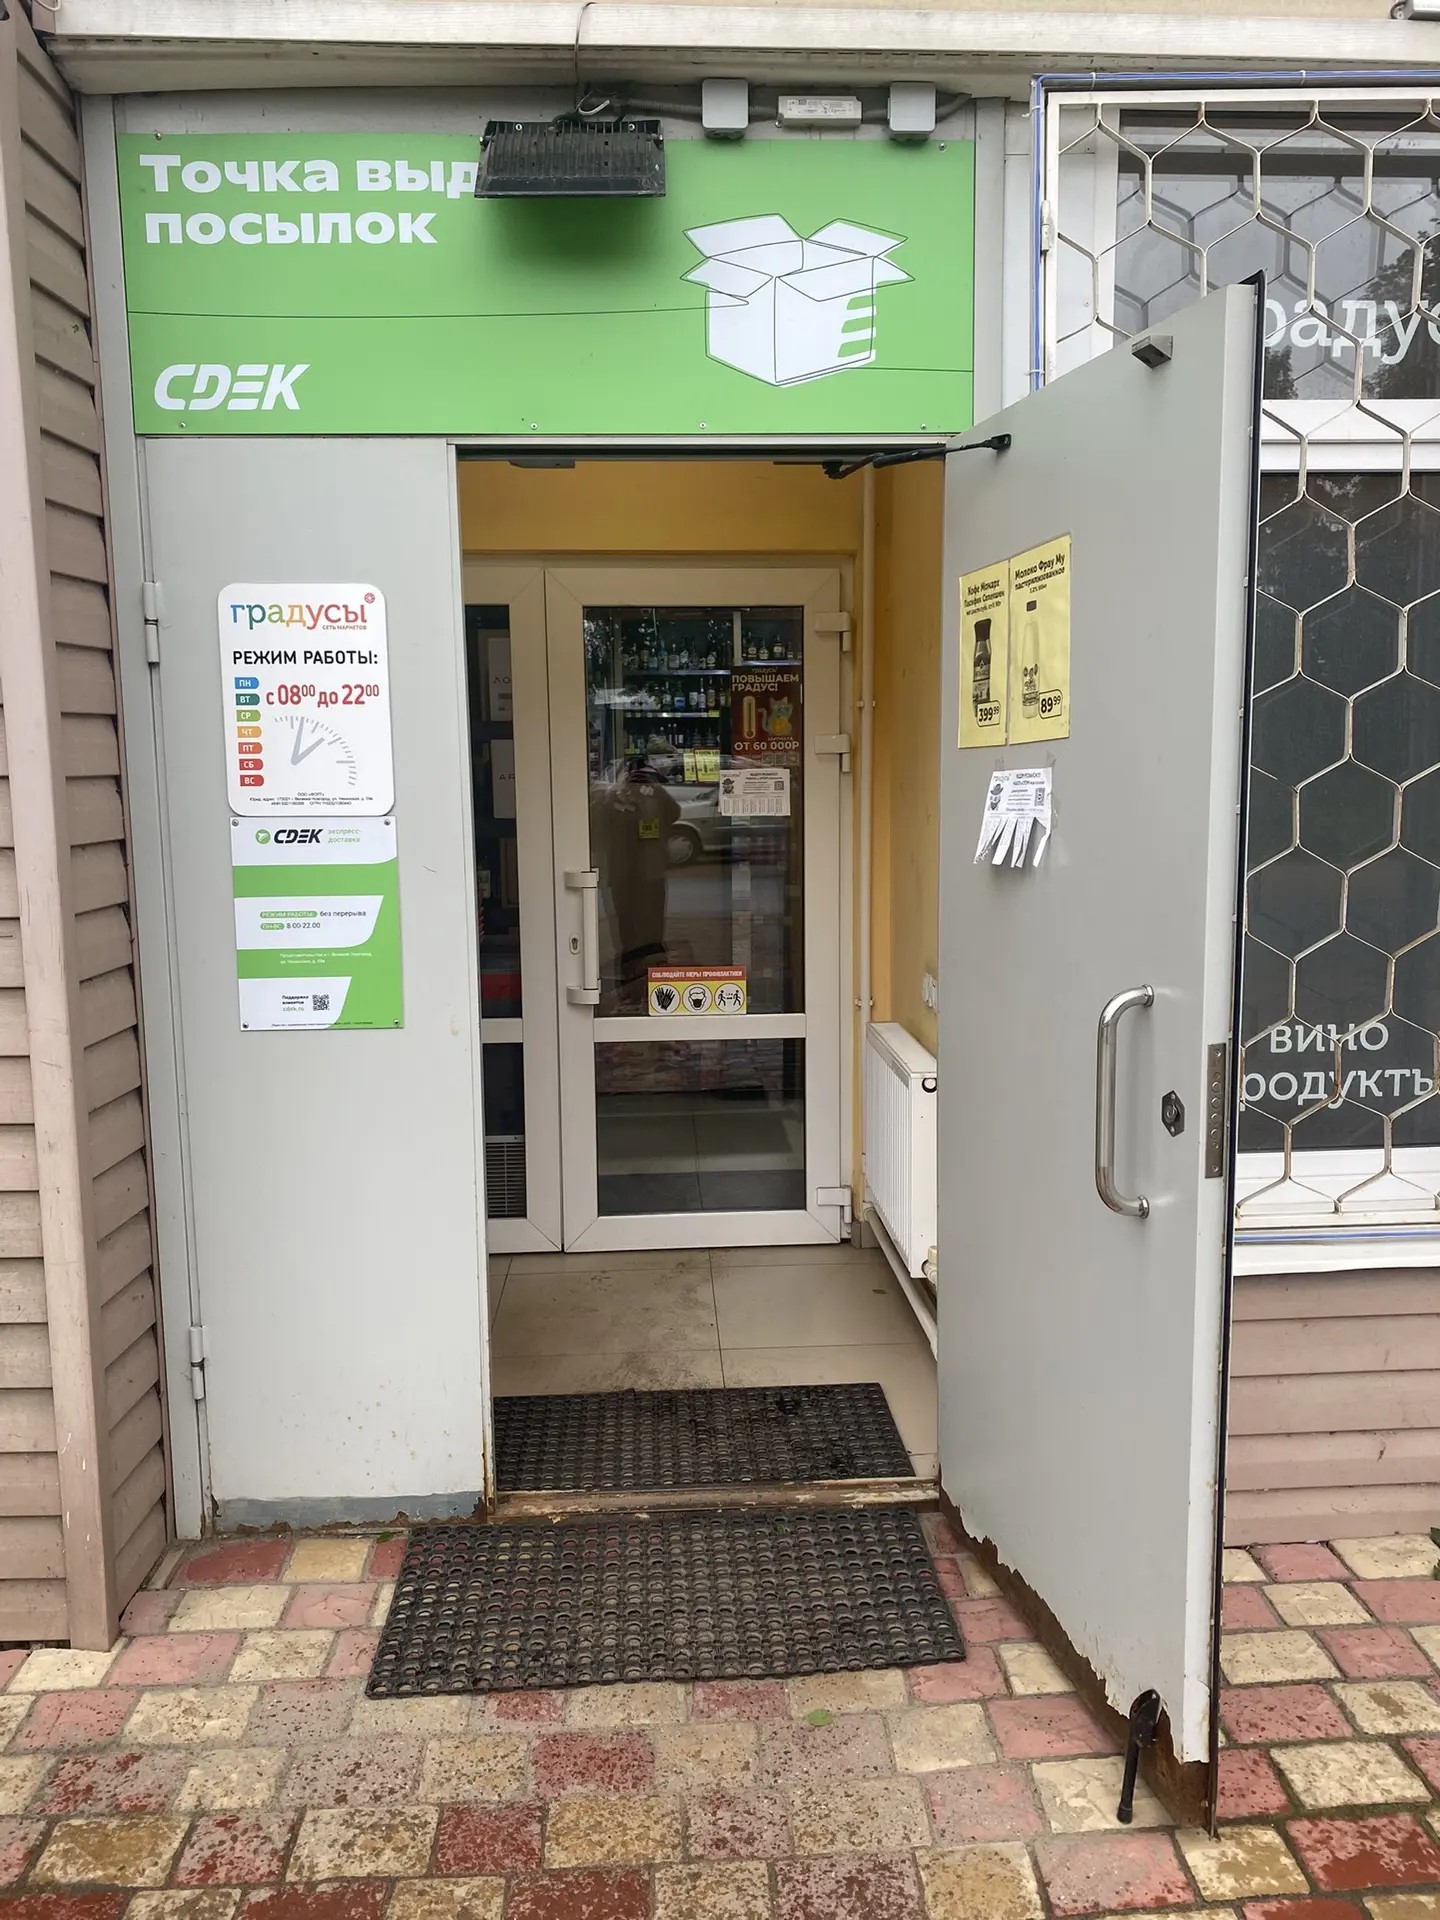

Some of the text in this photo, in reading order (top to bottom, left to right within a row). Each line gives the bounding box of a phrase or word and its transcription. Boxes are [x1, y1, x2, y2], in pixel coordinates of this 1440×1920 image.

[139, 154, 339, 193] Точка
[145, 212, 438, 244] посылок
[154, 363, 310, 410] CDEK
[1014, 565, 1038, 581] Молоко
[1055, 553, 1066, 566] Му
[967, 585, 980, 596] Кофе
[230, 604, 368, 630] градусы
[233, 650, 378, 665] РЕЖИМ РАБОТЫ:
[239, 679, 252, 687] ПН
[731, 673, 799, 683] ПОВЫШАЕМ
[731, 683, 779, 692] ГРАДУС!
[317, 691, 339, 708] до
[241, 728, 253, 736] ЧТ
[242, 744, 254, 752] ПТ
[734, 742, 751, 751] ОТ
[753, 742, 767, 750] 60
[244, 777, 255, 785] ВС
[273, 829, 324, 844] CDEK
[652, 971, 684, 979] СОБЛЮДАЙТЕ
[702, 970, 743, 978] ПРОФИЛАКТИКИ
[1270, 1022, 1389, 1054] вино
